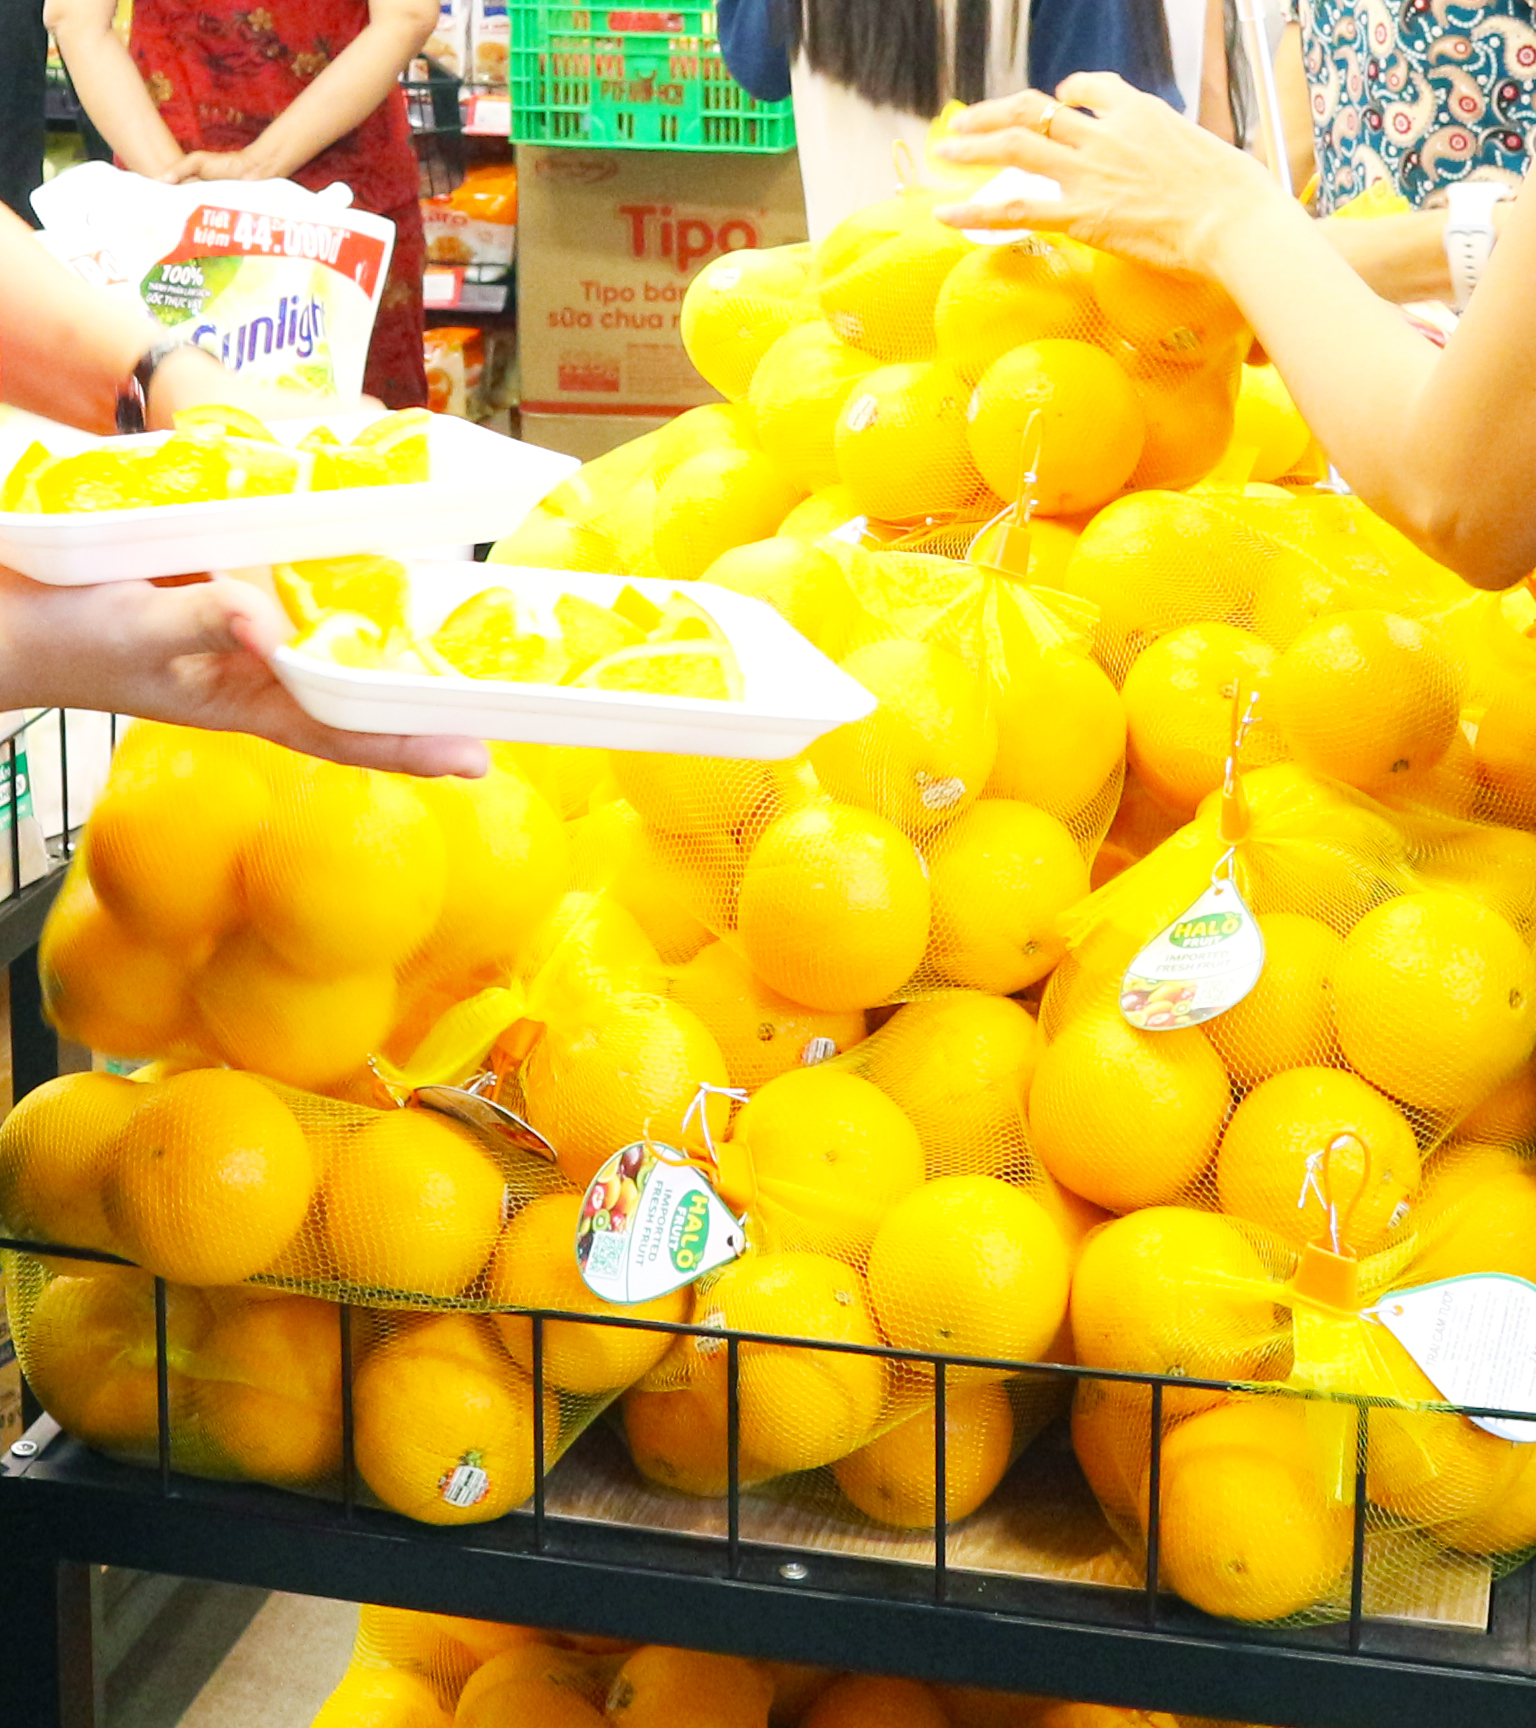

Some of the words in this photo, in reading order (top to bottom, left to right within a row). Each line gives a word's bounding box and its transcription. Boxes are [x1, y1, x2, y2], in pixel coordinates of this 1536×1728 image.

[619, 204, 759, 273] Tipo
[161, 264, 205, 287] 100%
[580, 280, 635, 307] Tipo
[1173, 917, 1240, 939] HALO
[1183, 935, 1224, 949] FRUIT
[1156, 961, 1195, 973] FRESH
[1196, 958, 1232, 971] FRUIT
[1164, 950, 1229, 963] IMPORTED
[646, 1179, 664, 1224] FRESH
[648, 1188, 673, 1262] IMPORTED
[669, 1205, 688, 1253] FRUIT
[676, 1194, 710, 1269] HALO
[635, 1226, 652, 1267] FRUIT
